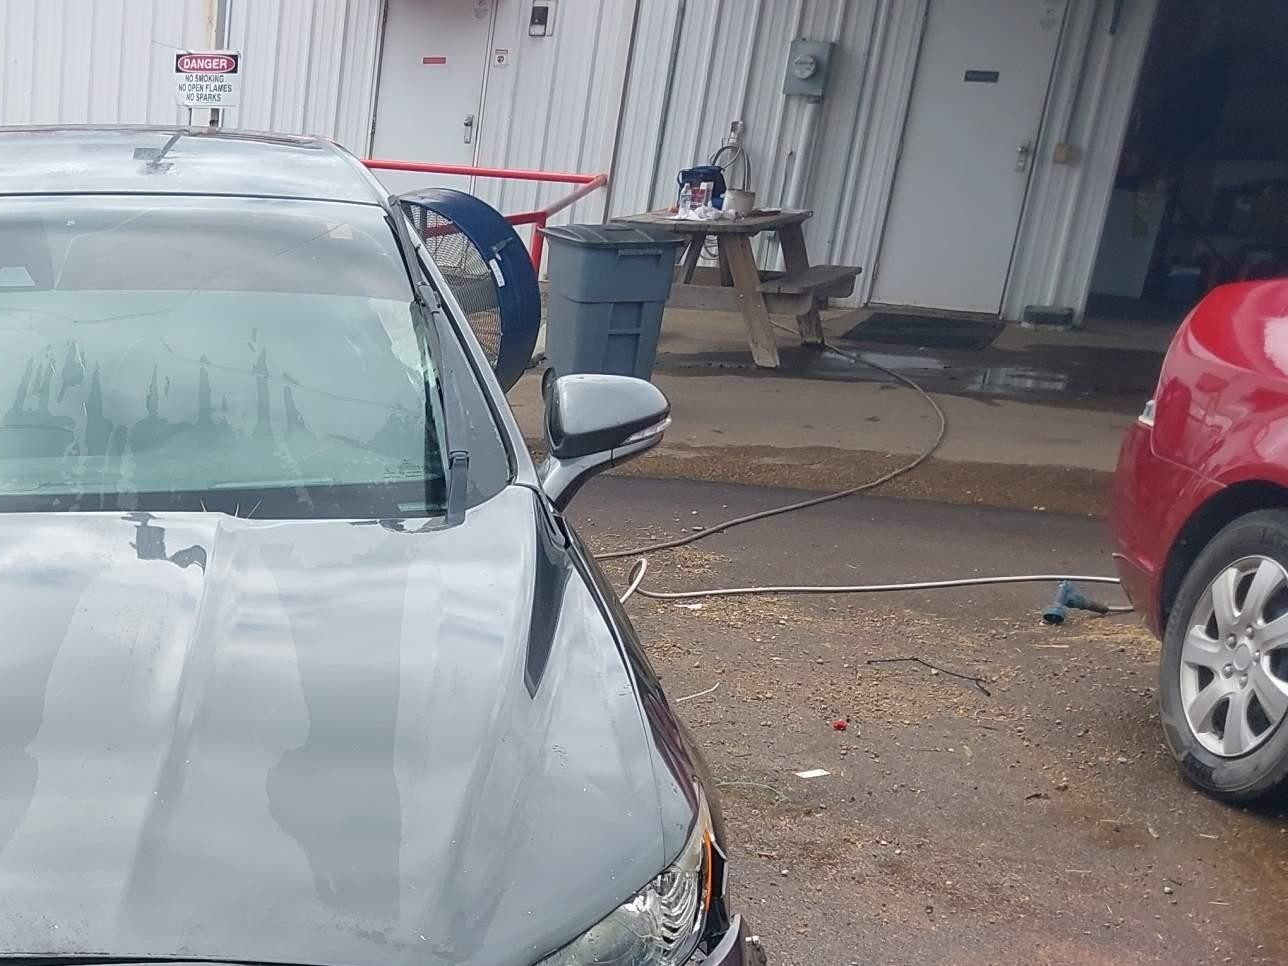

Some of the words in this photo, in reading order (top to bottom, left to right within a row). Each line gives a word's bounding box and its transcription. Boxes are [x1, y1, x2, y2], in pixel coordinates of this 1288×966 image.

[183, 58, 228, 69] DANGER
[185, 74, 193, 82] NO
[194, 75, 224, 83] SMOKING
[187, 84, 204, 92] OPEN
[205, 84, 232, 92] FLAMES
[186, 93, 195, 101] NO
[196, 93, 222, 102] SPARKS
